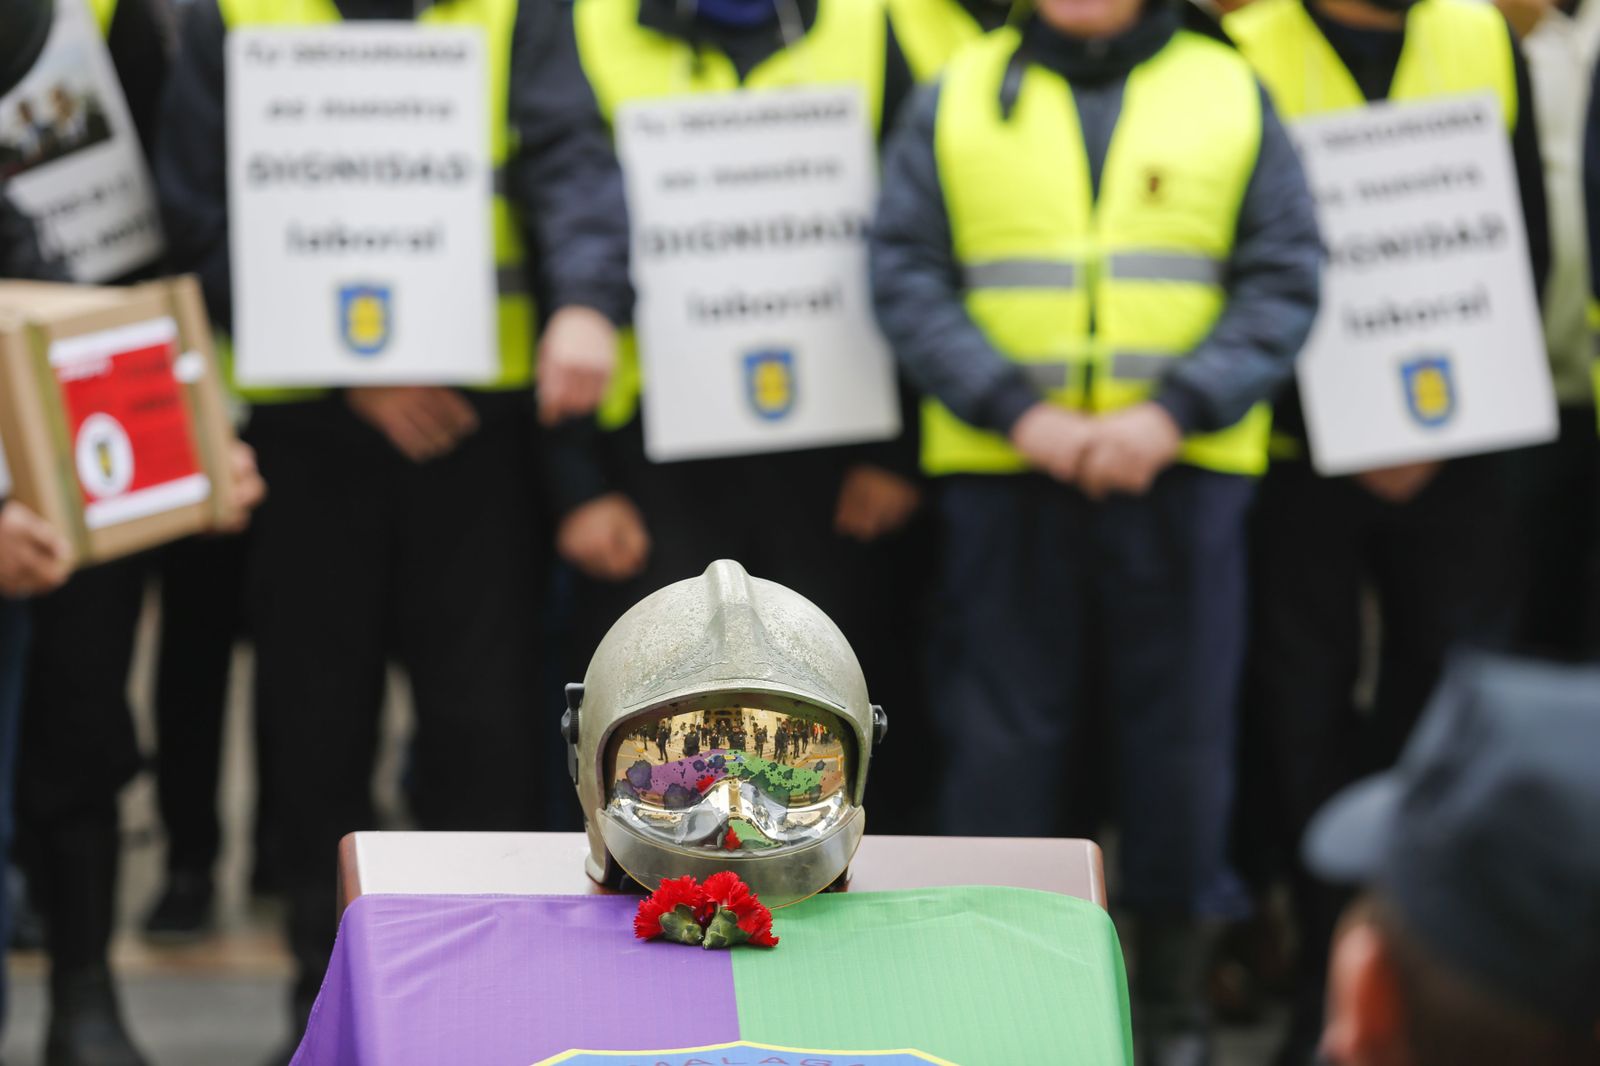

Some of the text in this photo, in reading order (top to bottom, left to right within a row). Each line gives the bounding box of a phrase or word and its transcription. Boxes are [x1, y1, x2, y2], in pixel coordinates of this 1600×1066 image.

[246, 153, 472, 189] DIGNIDAD
[286, 223, 443, 255] laboral
[692, 288, 846, 324] laboral
[1344, 290, 1490, 333] laboral
